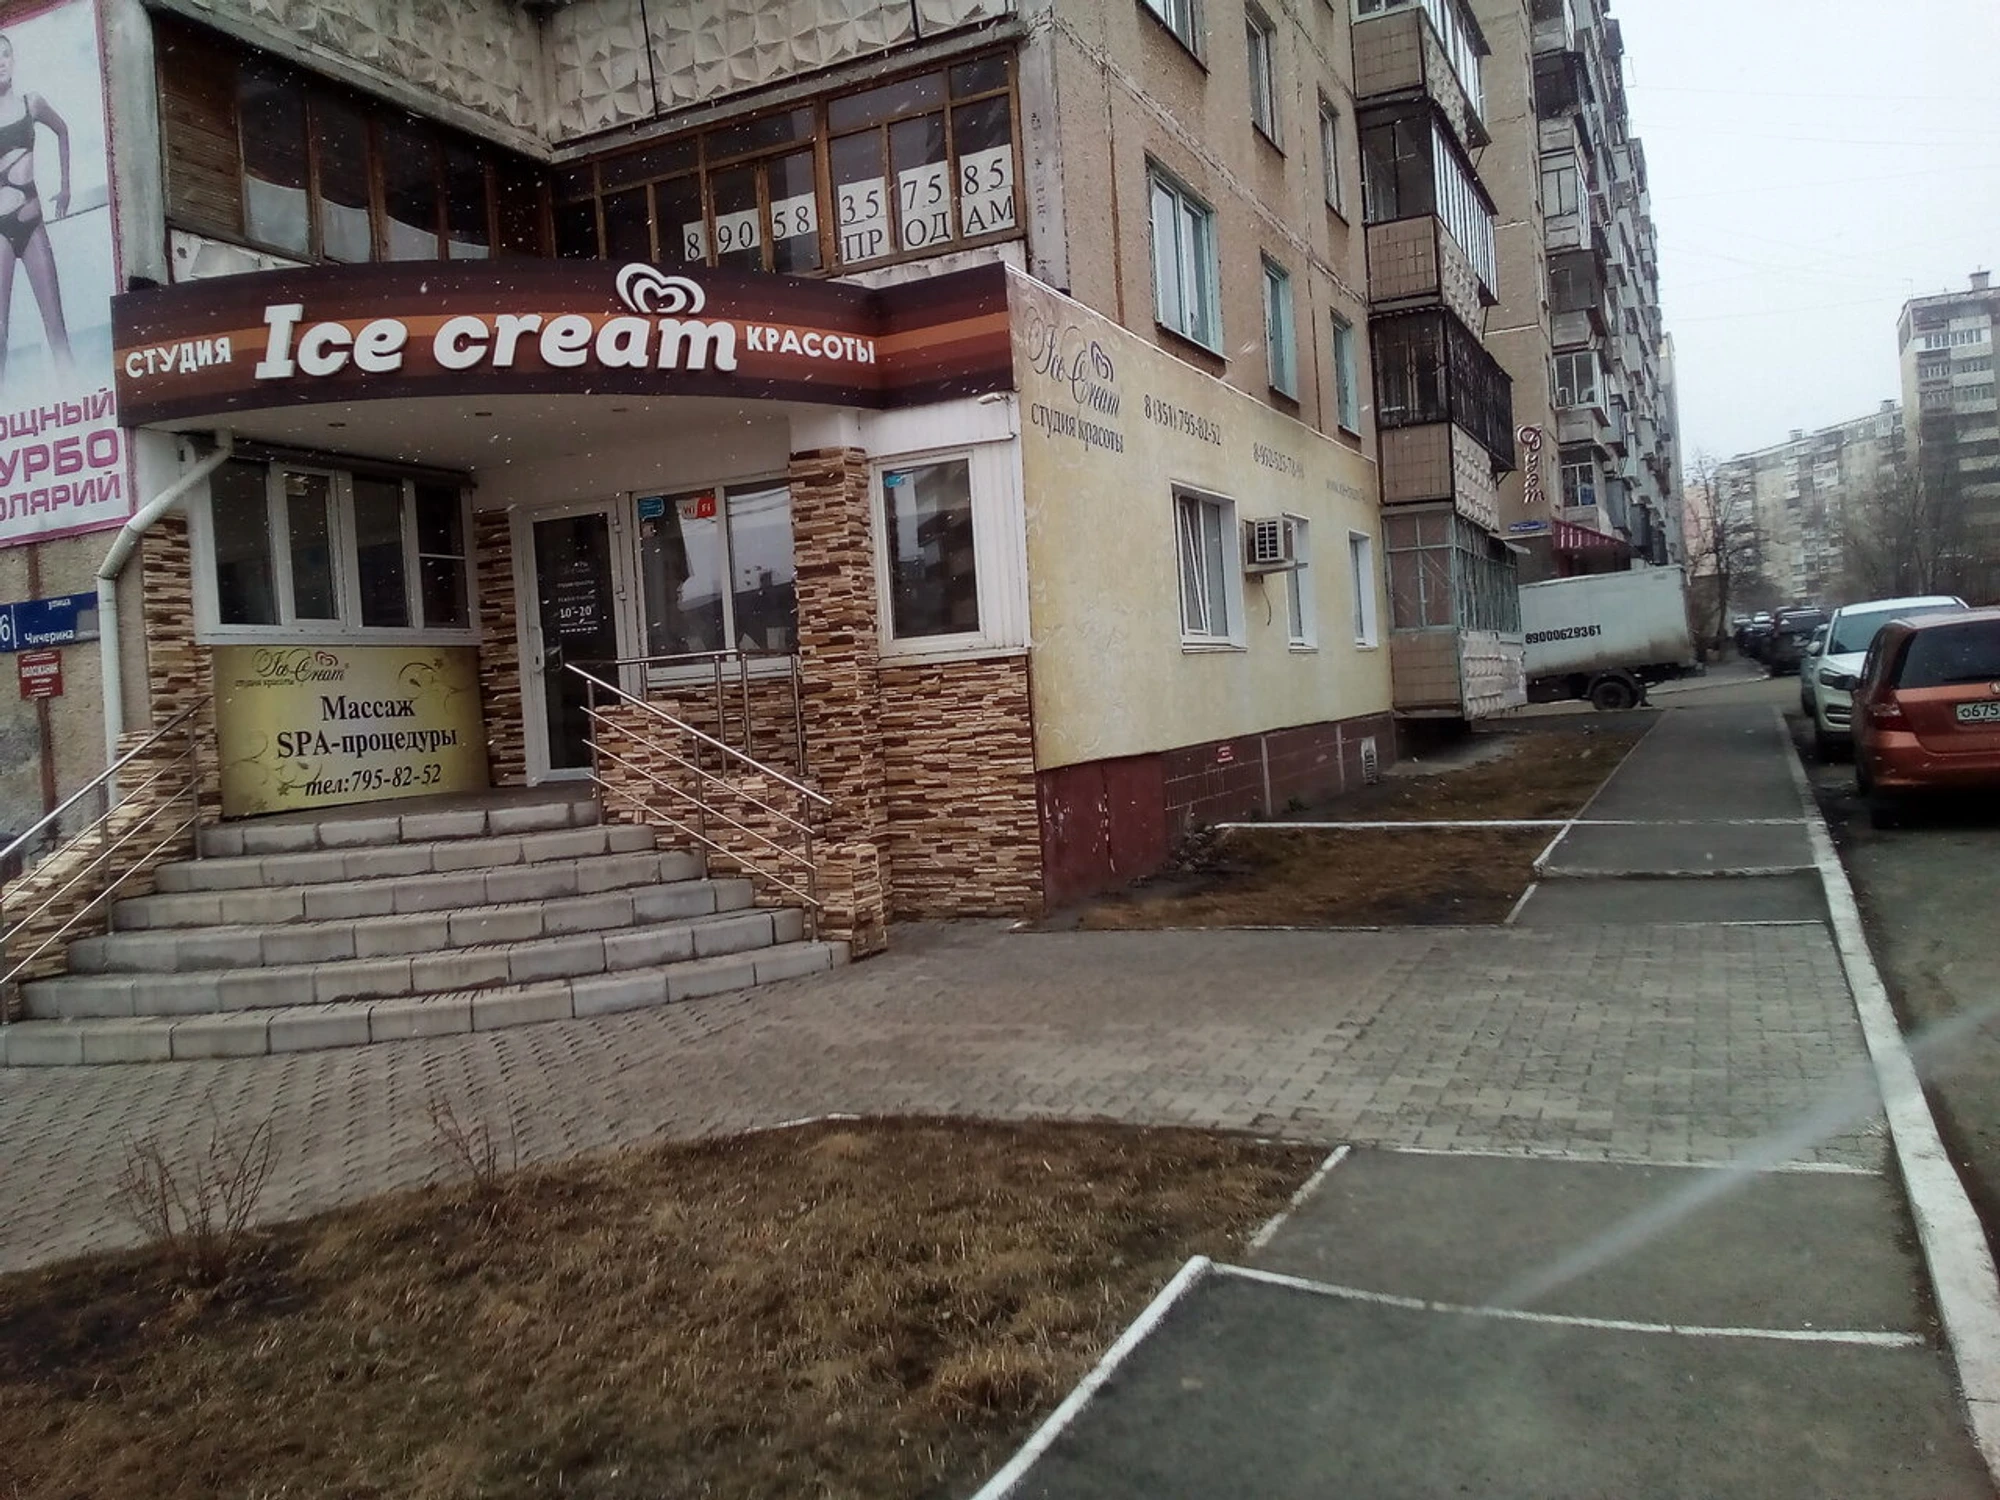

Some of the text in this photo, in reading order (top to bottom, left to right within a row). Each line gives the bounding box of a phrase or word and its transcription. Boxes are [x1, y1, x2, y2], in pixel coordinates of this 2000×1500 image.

[125, 304, 876, 380] СТУДИЯ Ice cream КРАСОТЫ
[1031, 403, 1124, 453] студия красоты
[24, 629, 74, 644] Чичерина
[1525, 624, 1602, 645] 89000629361
[320, 695, 416, 721] Массаж
[277, 728, 458, 759] SPA-процедуры
